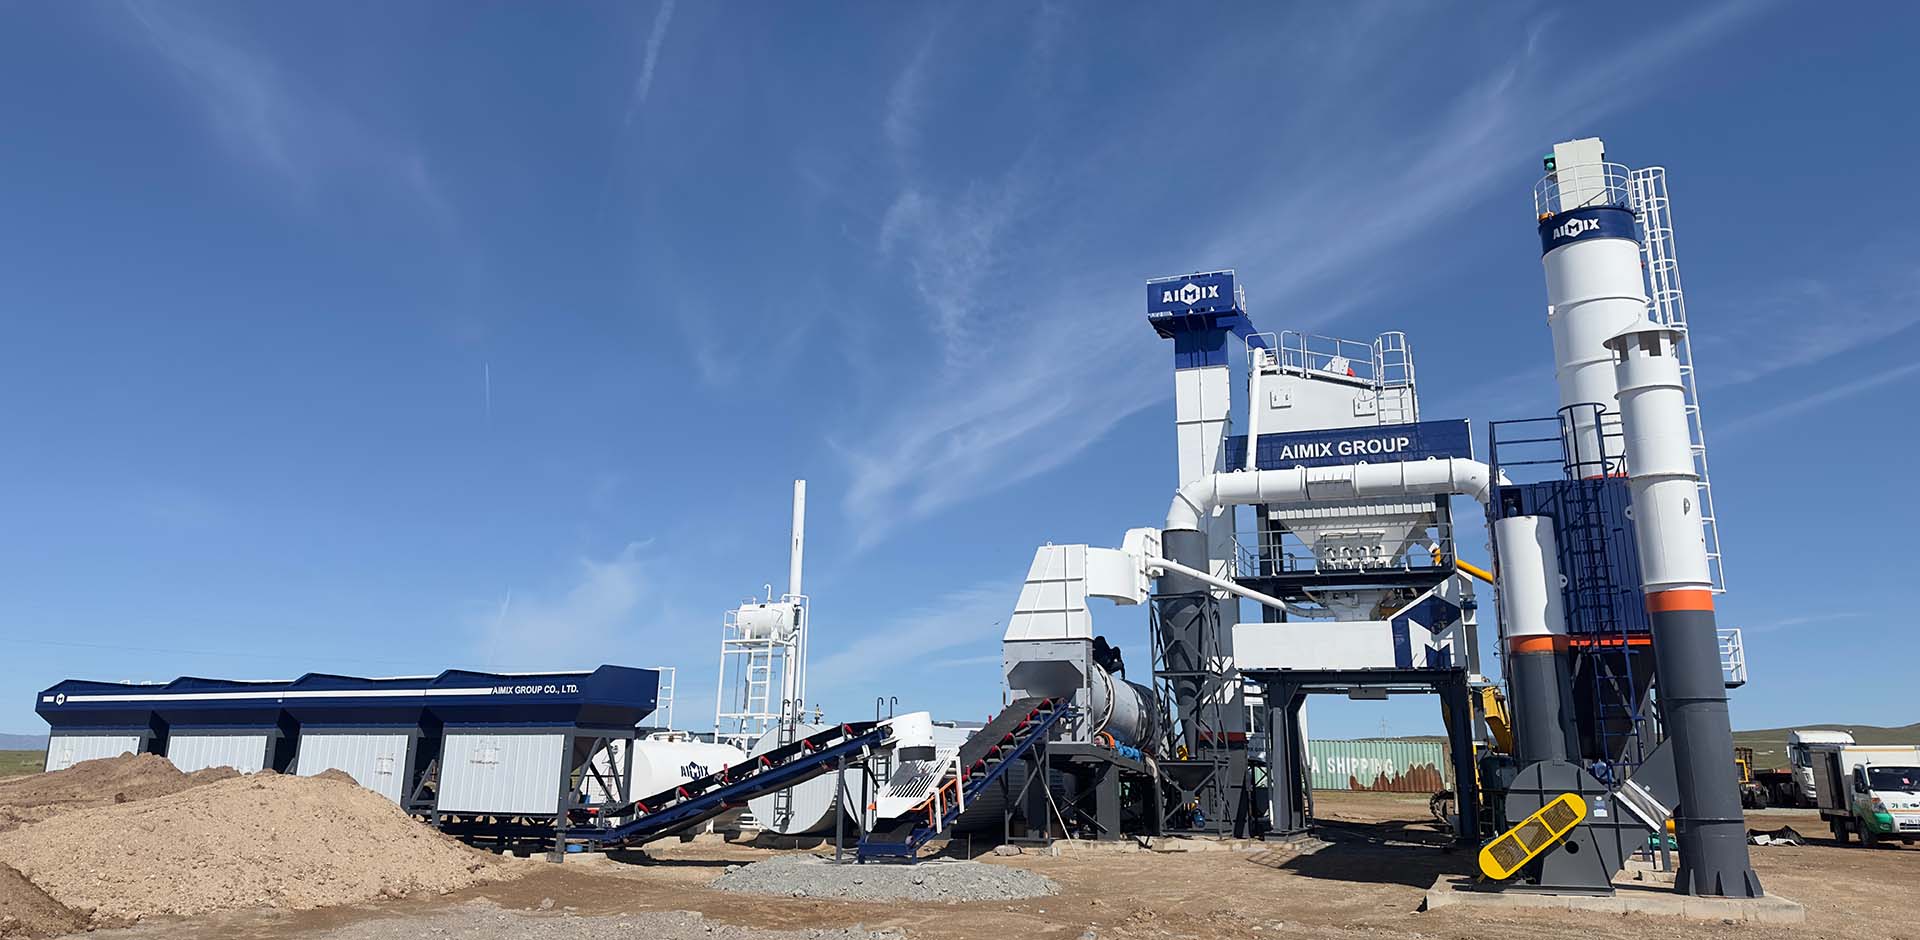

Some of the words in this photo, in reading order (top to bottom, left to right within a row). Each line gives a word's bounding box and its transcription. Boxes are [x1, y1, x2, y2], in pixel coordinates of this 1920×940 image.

[1553, 218, 1600, 240] AIMIX
[1162, 283, 1219, 305] AIMIX
[1280, 442, 1333, 460] AIMIX
[1338, 437, 1409, 456] GROUP
[492, 686, 513, 695] AIMIX
[514, 685, 542, 695] GROUP
[544, 685, 560, 695] CO.,
[561, 684, 579, 693] LTD.
[680, 761, 710, 781] AIMIX
[1327, 756, 1394, 775] SHIPPING
